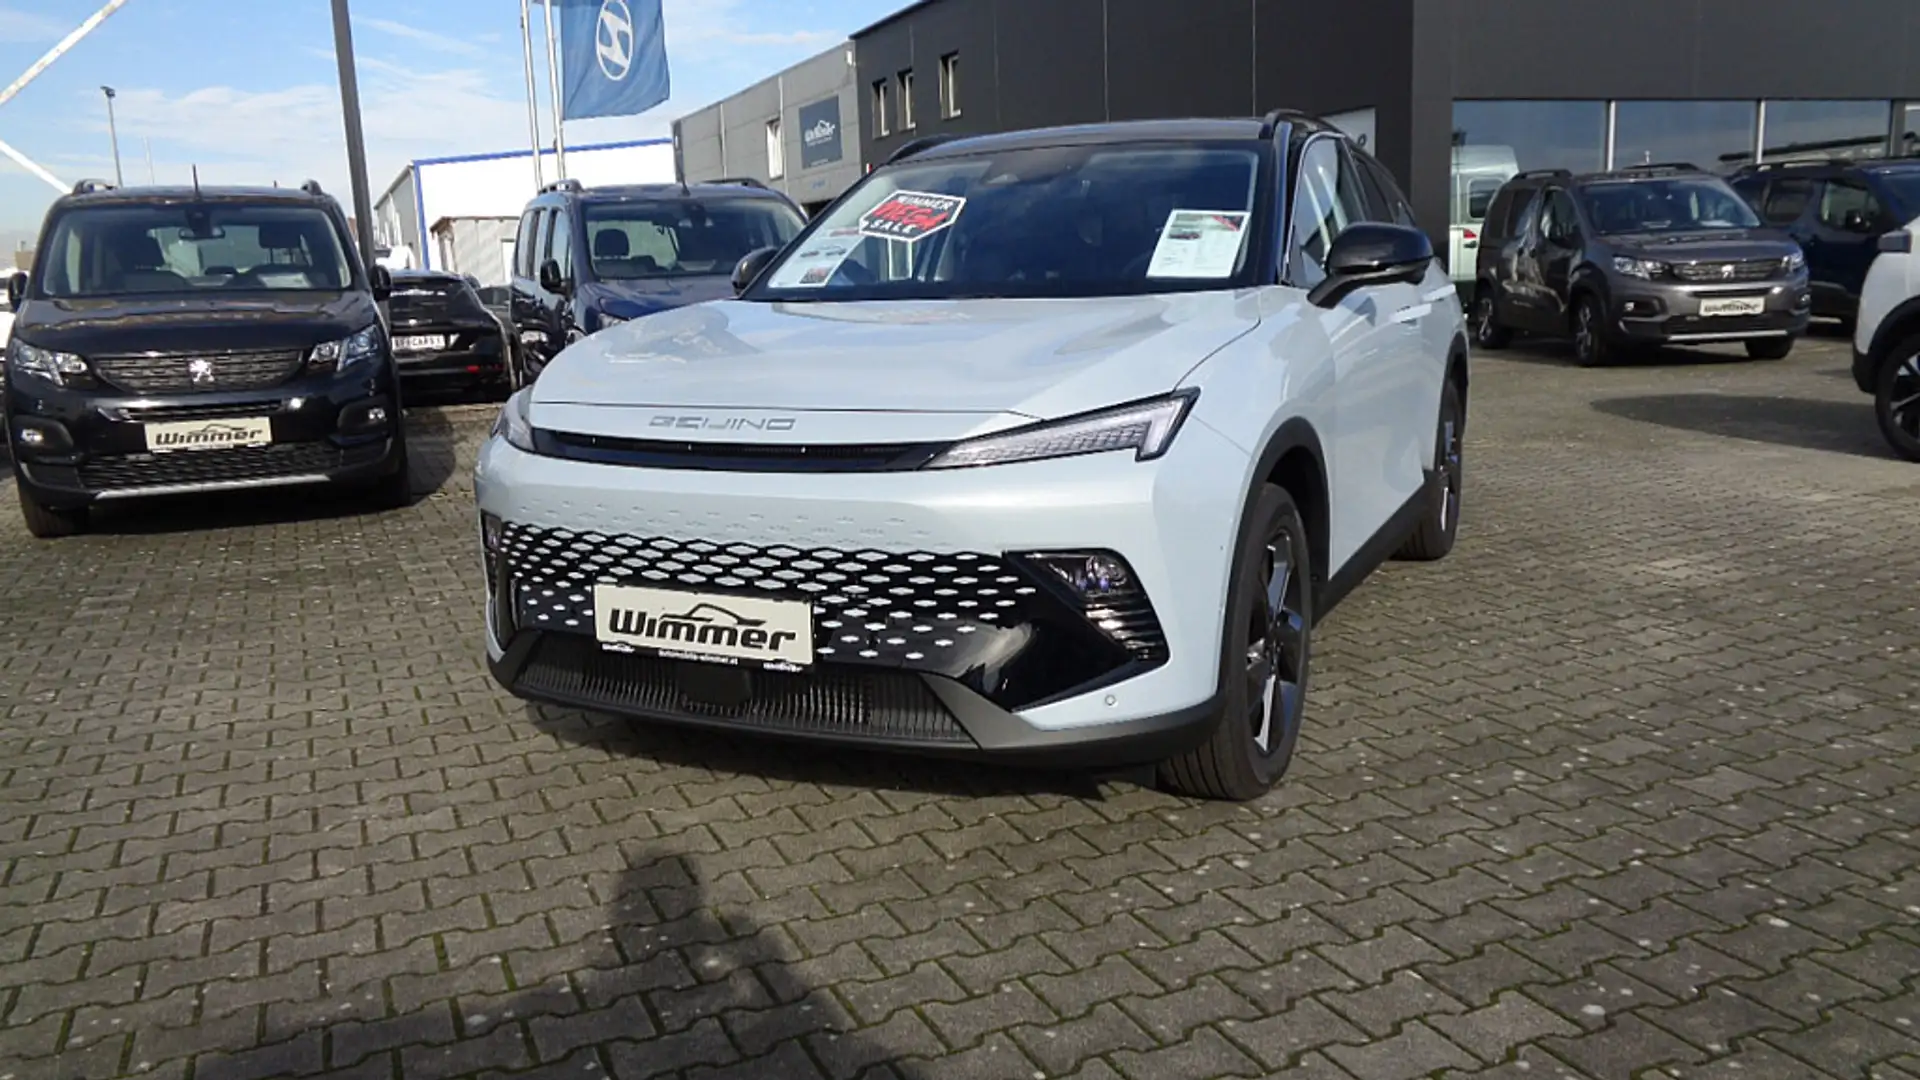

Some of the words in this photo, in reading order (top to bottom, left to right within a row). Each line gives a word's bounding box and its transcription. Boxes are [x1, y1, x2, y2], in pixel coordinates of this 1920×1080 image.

[870, 219, 917, 234] SALE
[155, 429, 263, 446] Wimmer
[609, 608, 796, 651] Wimmer
